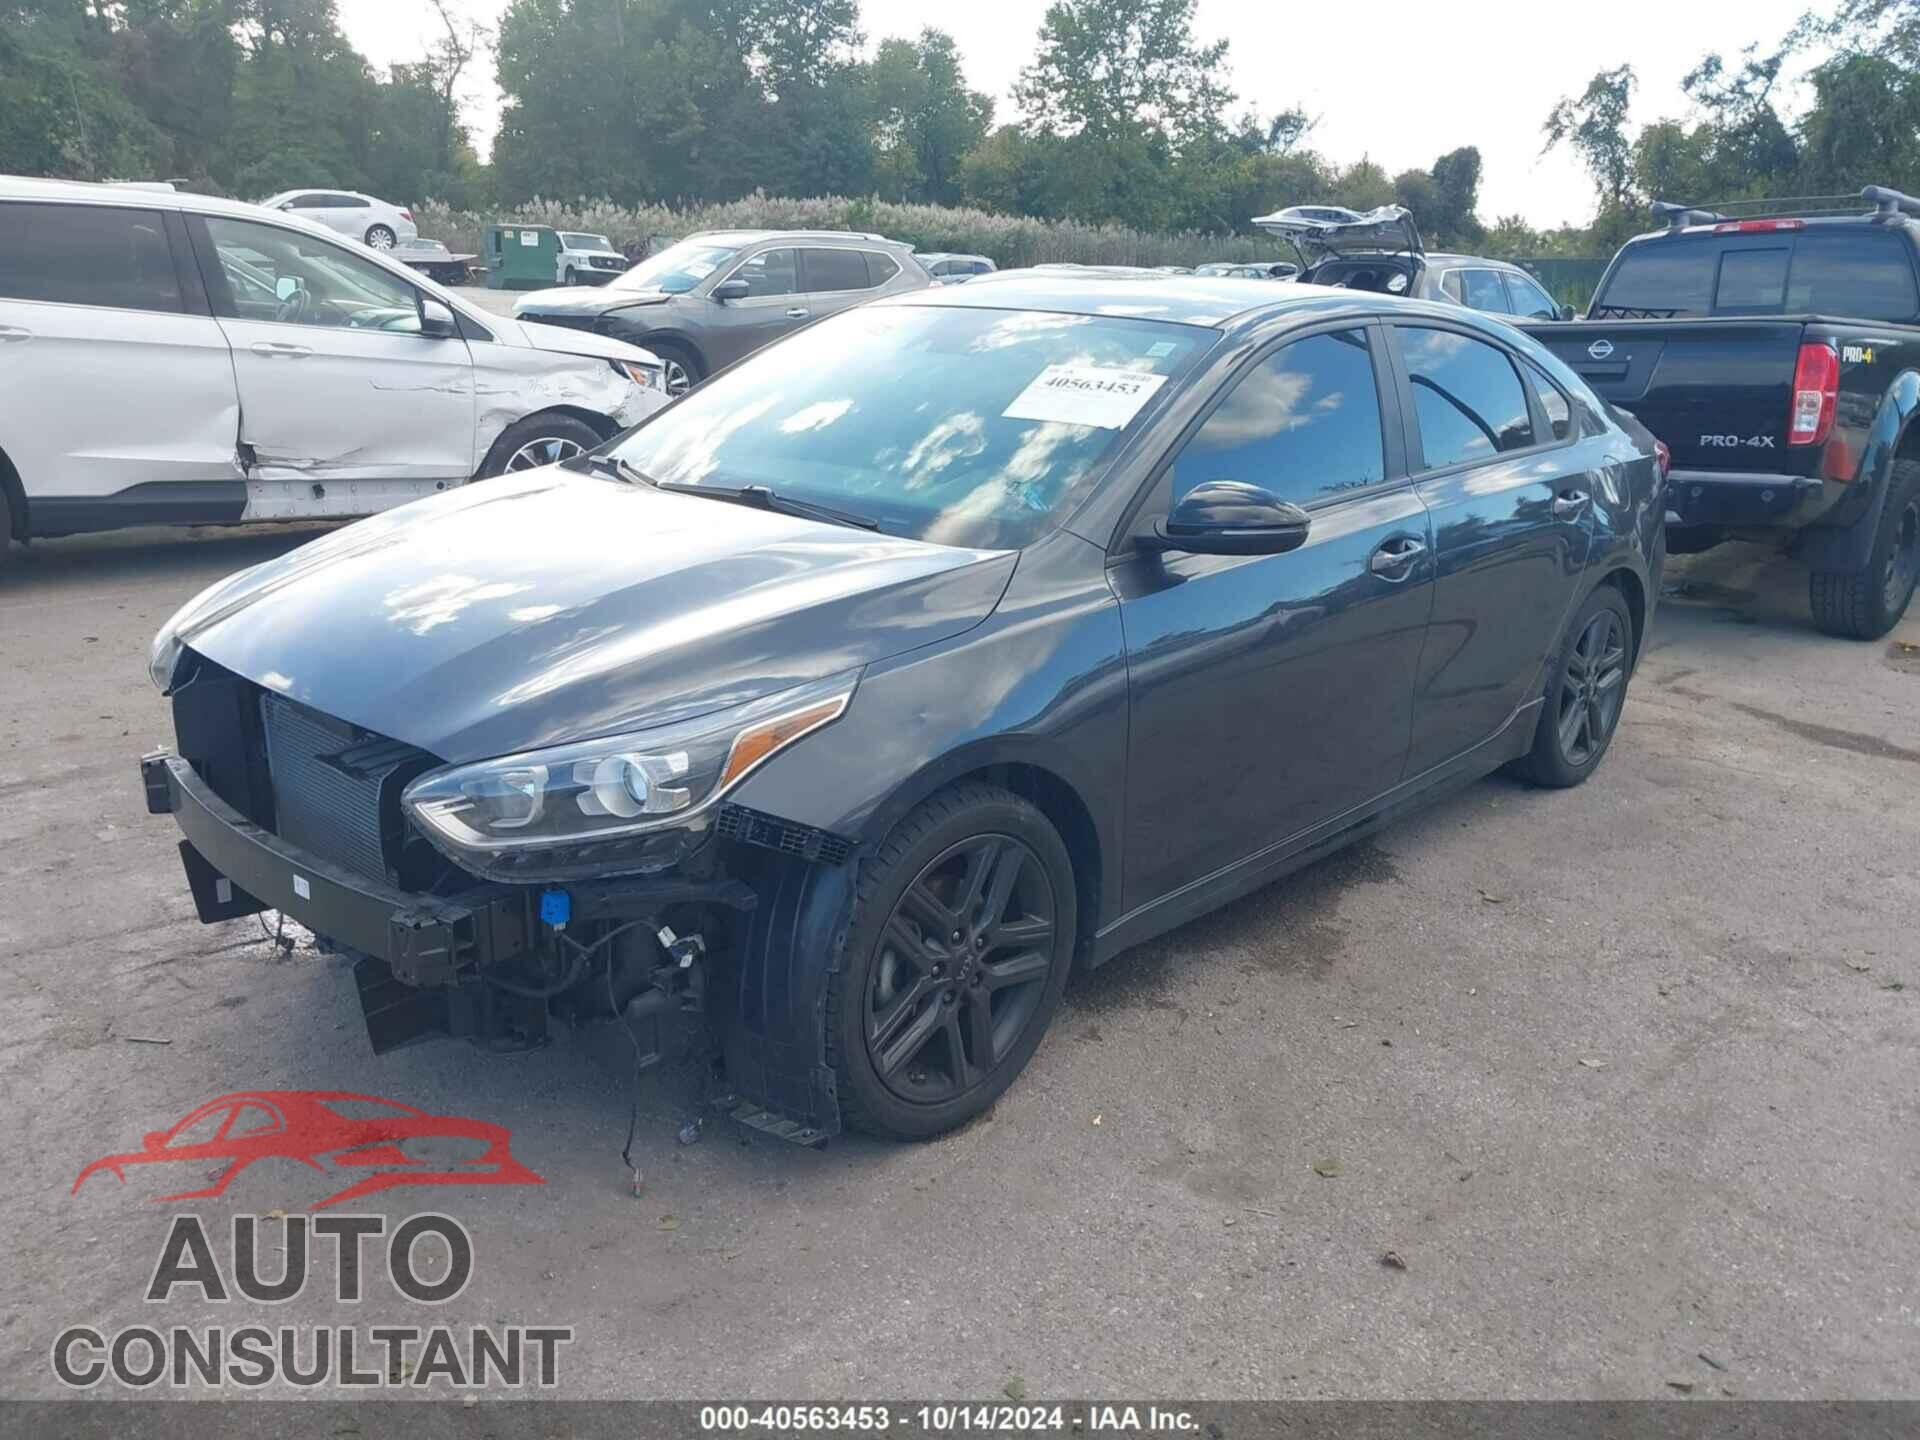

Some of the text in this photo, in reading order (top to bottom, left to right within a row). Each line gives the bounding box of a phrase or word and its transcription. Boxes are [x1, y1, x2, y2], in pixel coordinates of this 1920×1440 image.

[1843, 346, 1877, 363] PRO-4
[1045, 376, 1142, 395] 40563453
[1700, 435, 1775, 448] PRO-4X
